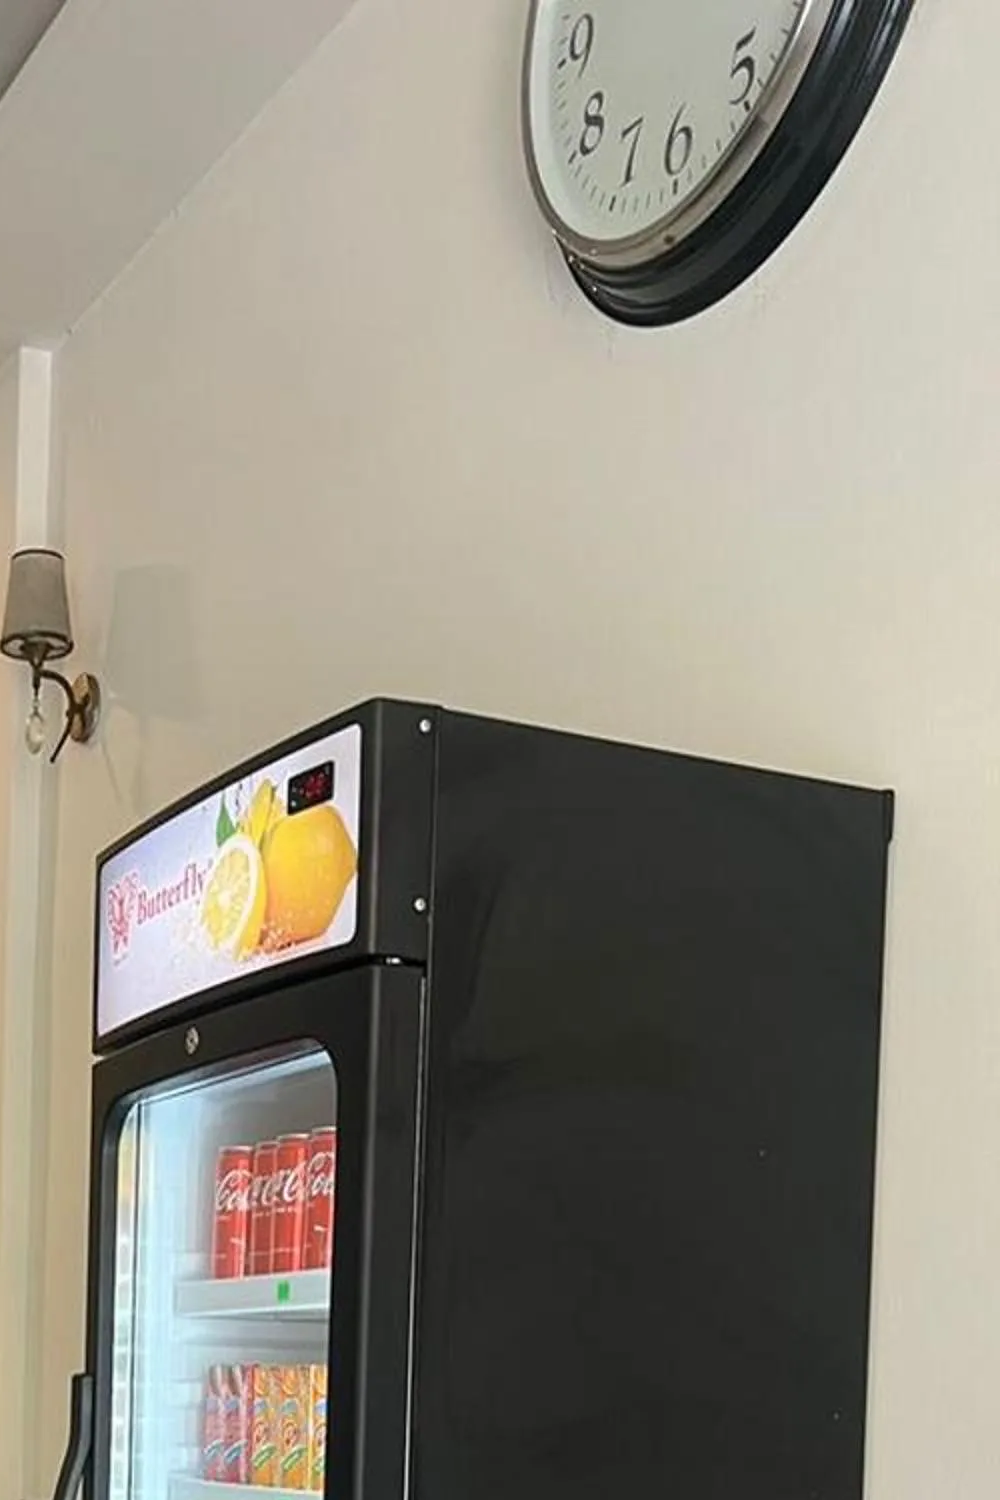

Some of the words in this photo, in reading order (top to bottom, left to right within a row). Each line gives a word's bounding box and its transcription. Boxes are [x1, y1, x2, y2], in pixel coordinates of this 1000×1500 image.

[569, 13, 594, 78] 9
[729, 25, 756, 105] 5
[579, 90, 604, 156] 8
[621, 116, 644, 187] 7
[664, 102, 692, 176] 6
[136, 862, 206, 925] Butterfly
